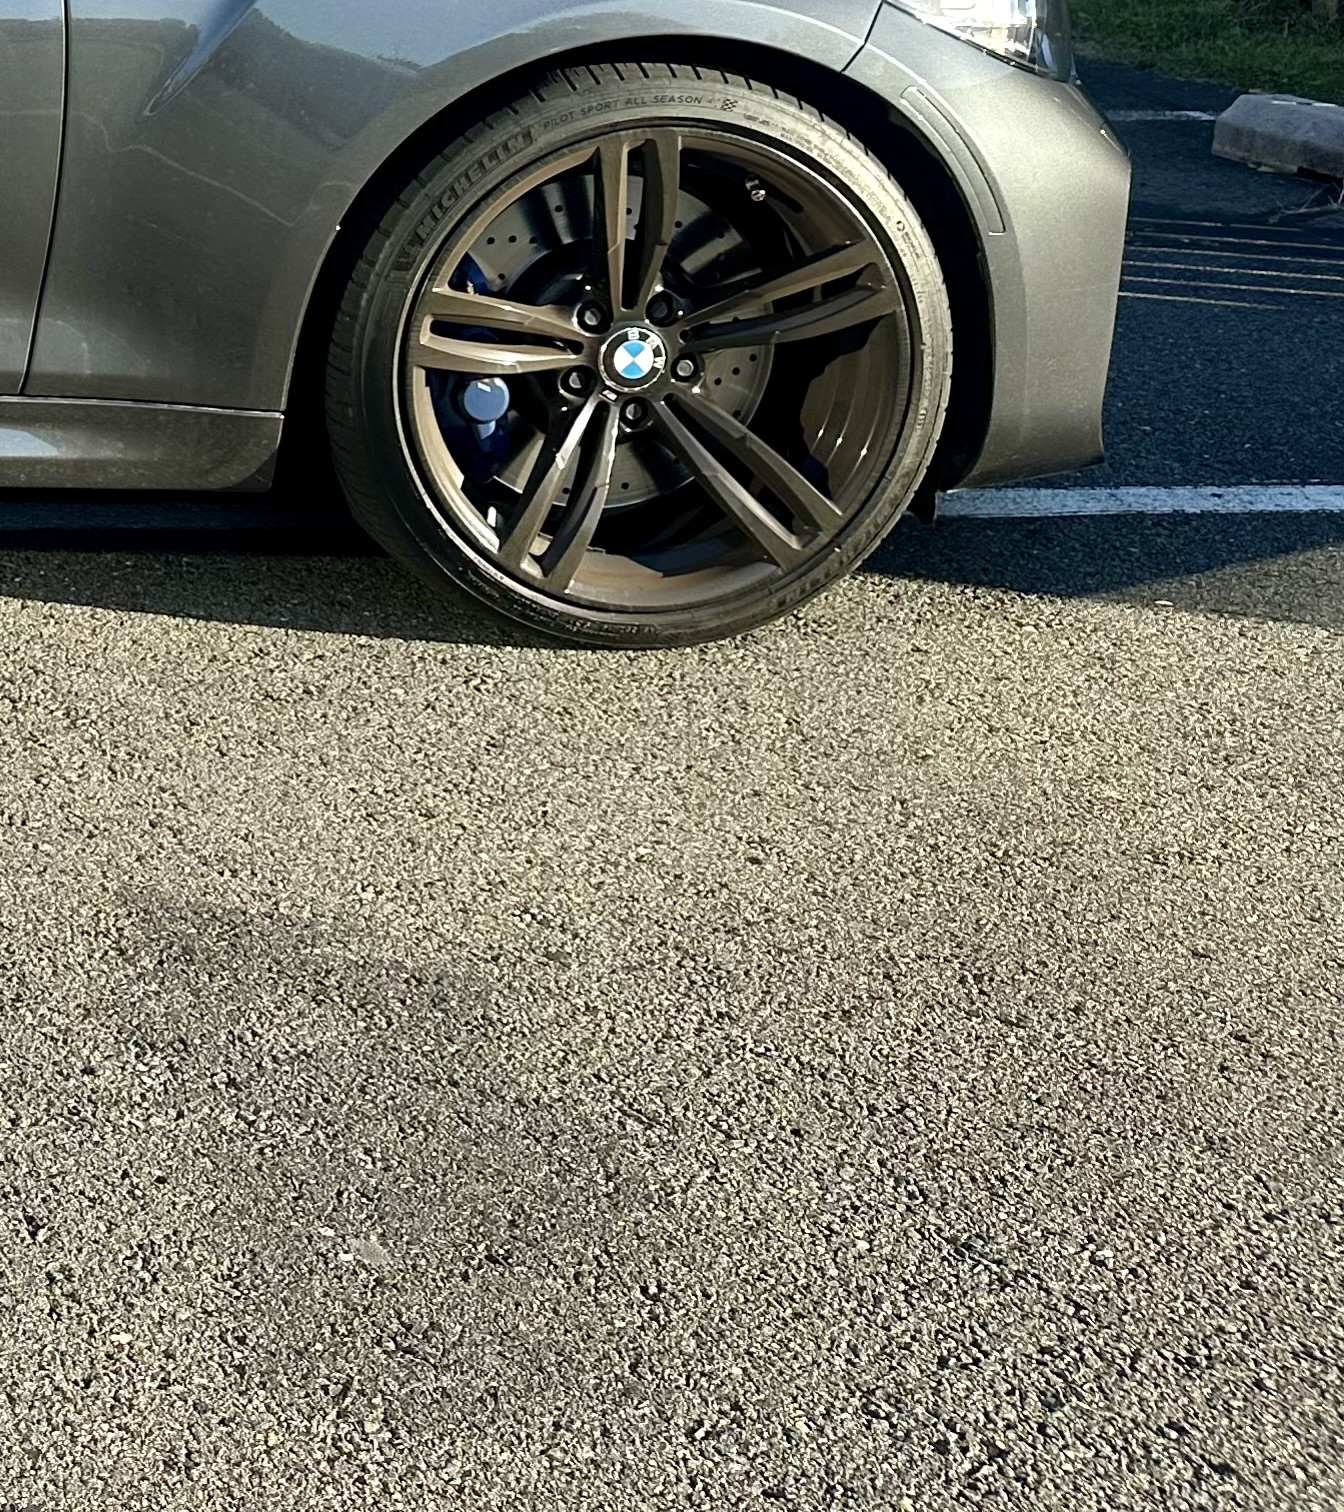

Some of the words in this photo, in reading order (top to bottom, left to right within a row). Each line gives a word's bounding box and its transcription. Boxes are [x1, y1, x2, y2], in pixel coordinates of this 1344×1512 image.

[543, 110, 576, 130] PILOT
[580, 98, 620, 117] SPORT
[625, 97, 647, 106] ALL
[652, 94, 704, 105] SEASON
[415, 131, 528, 240] MICHELIN
